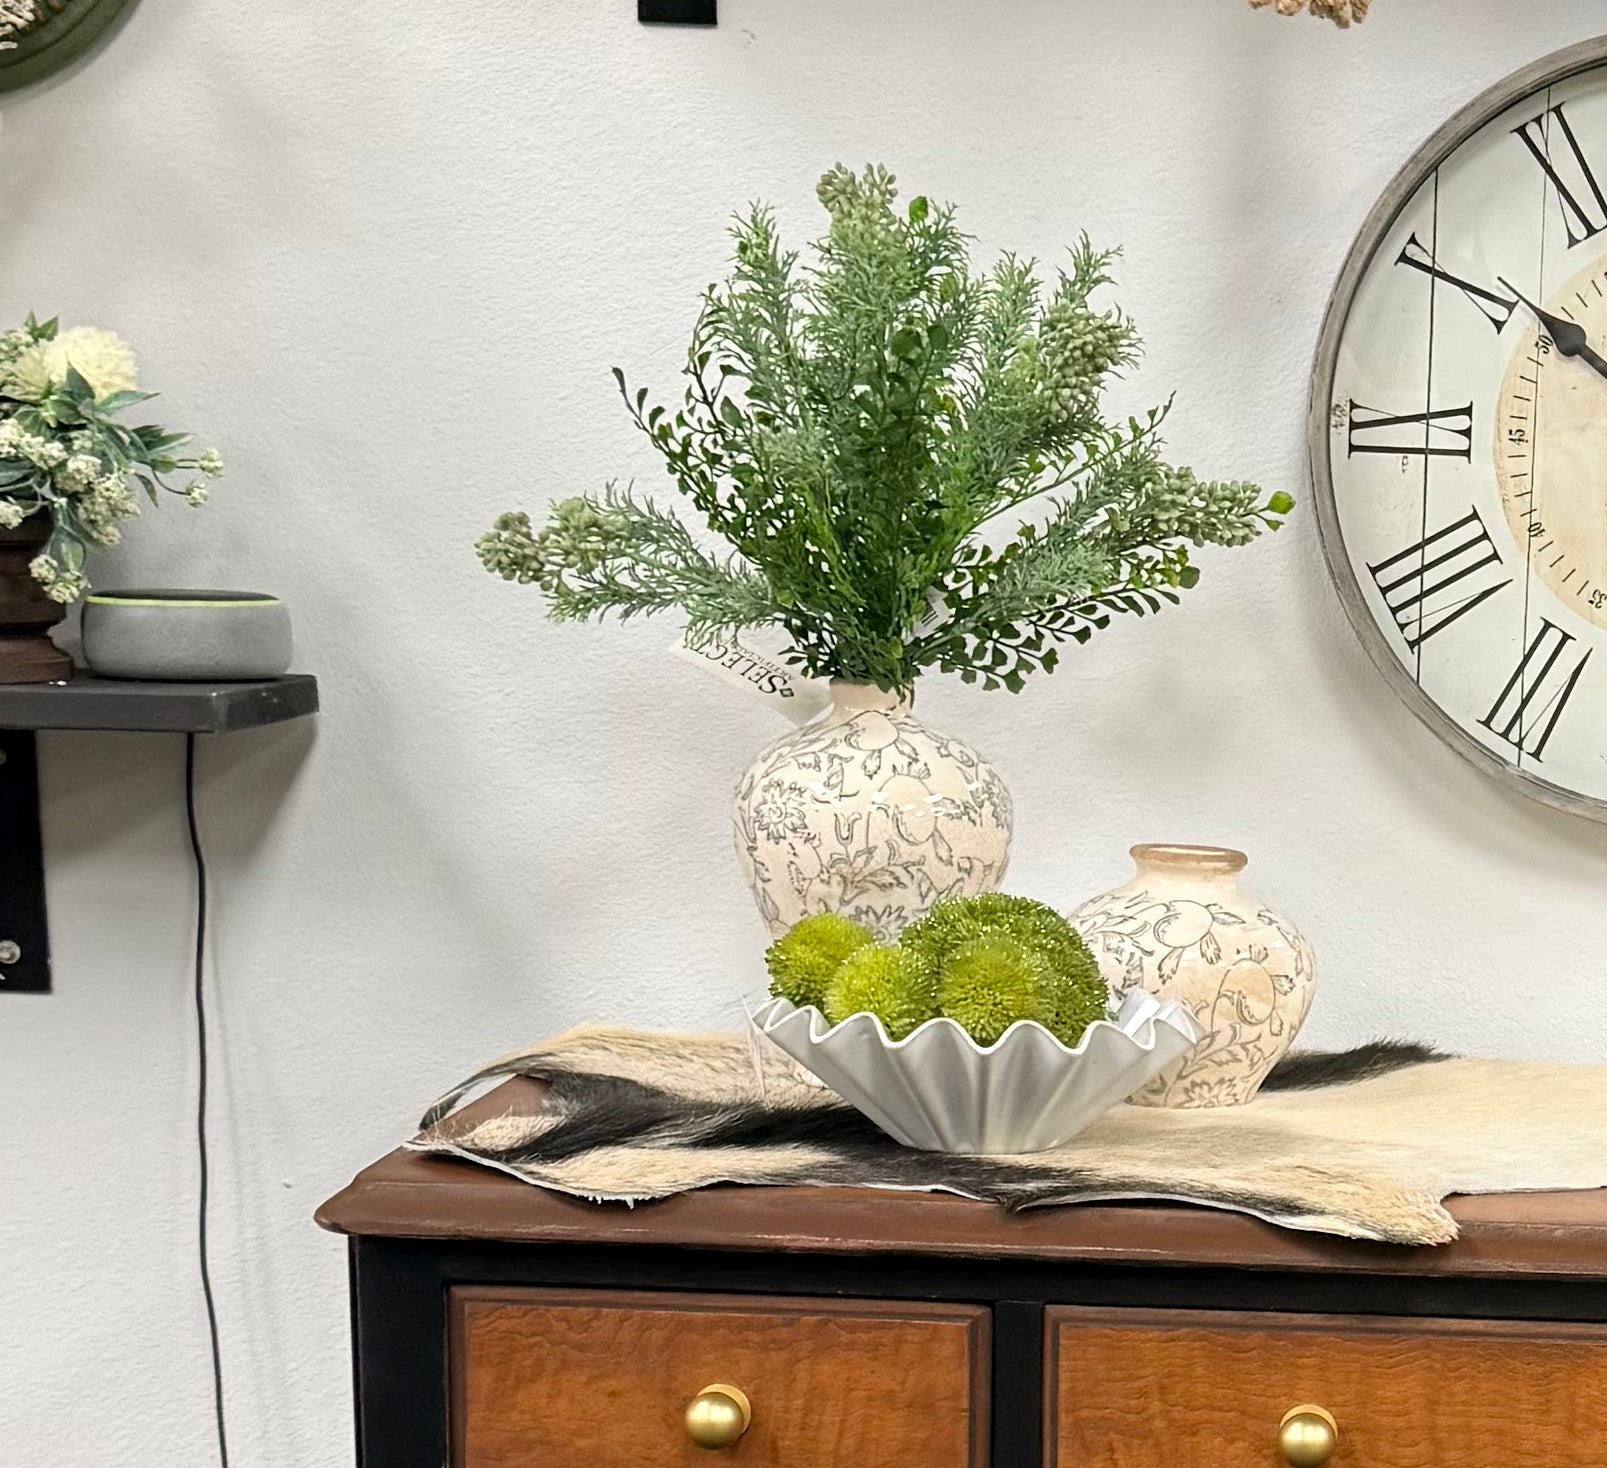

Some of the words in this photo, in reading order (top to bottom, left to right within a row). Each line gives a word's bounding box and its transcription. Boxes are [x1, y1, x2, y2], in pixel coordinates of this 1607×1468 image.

[1534, 334, 1553, 355] 50
[1508, 428, 1529, 446] 45
[1527, 521, 1546, 538] 40
[1588, 588, 1607, 609] 35
